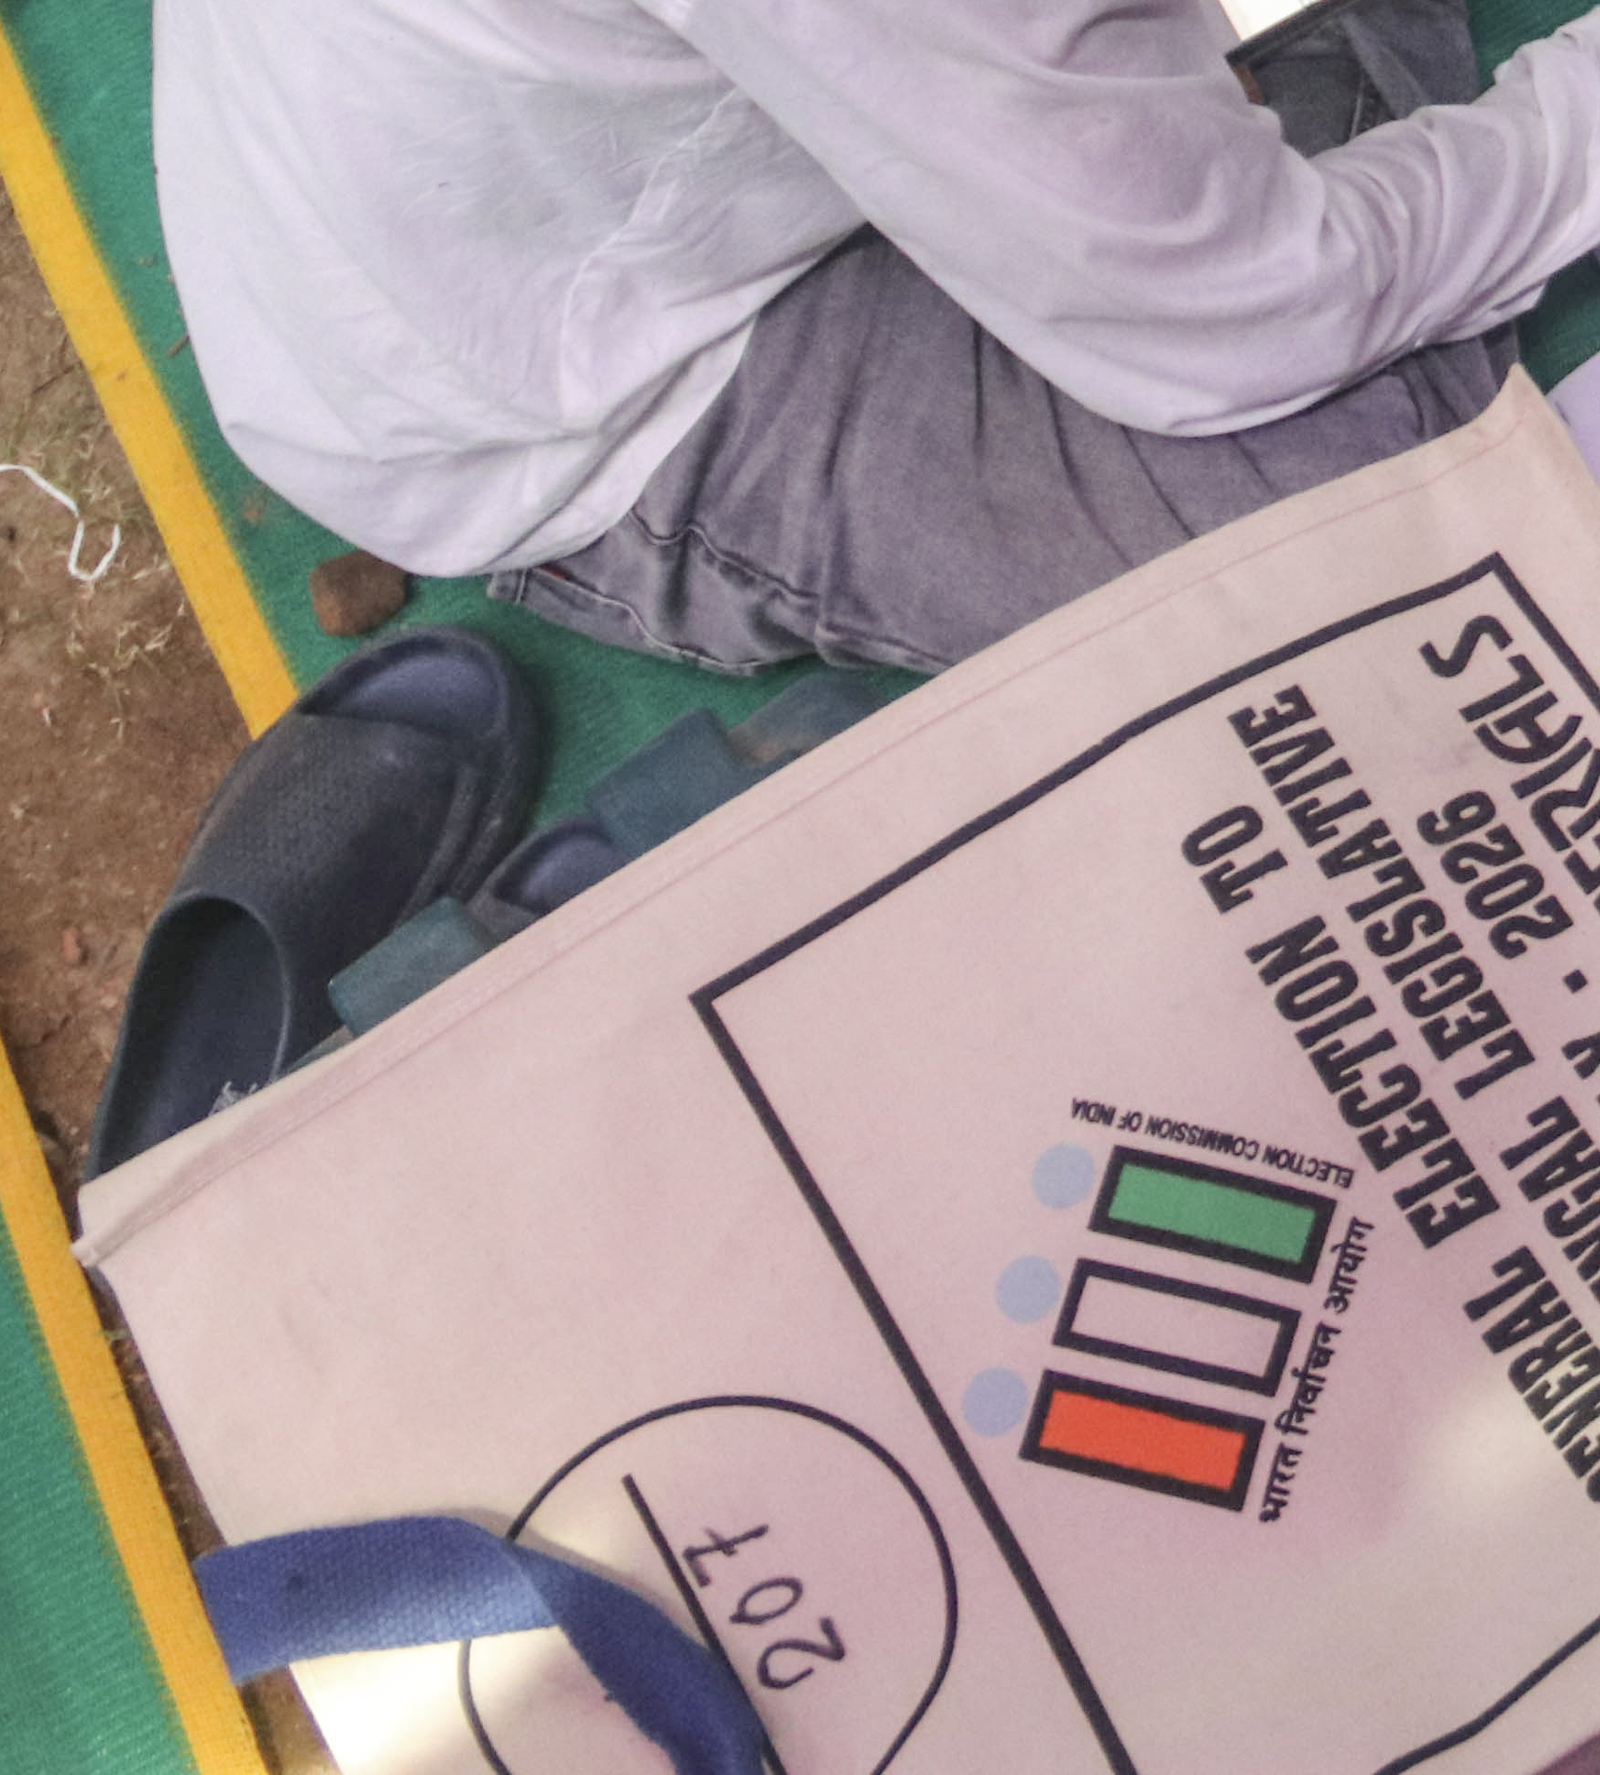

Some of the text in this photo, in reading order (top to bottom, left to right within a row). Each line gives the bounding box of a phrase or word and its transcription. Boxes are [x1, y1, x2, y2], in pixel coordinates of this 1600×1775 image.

[1181, 805, 1288, 914] TO
[1227, 684, 1535, 1100] LEGISLATIVE
[1416, 791, 1574, 960] 2026
[1072, 1098, 1355, 1189] ELECTION COMMISSION OF INDIA
[1245, 916, 1500, 1250] ELECTION
[1259, 1216, 1375, 1522] भारत निर्वाचन आयोग
[684, 1526, 845, 1689] 207
